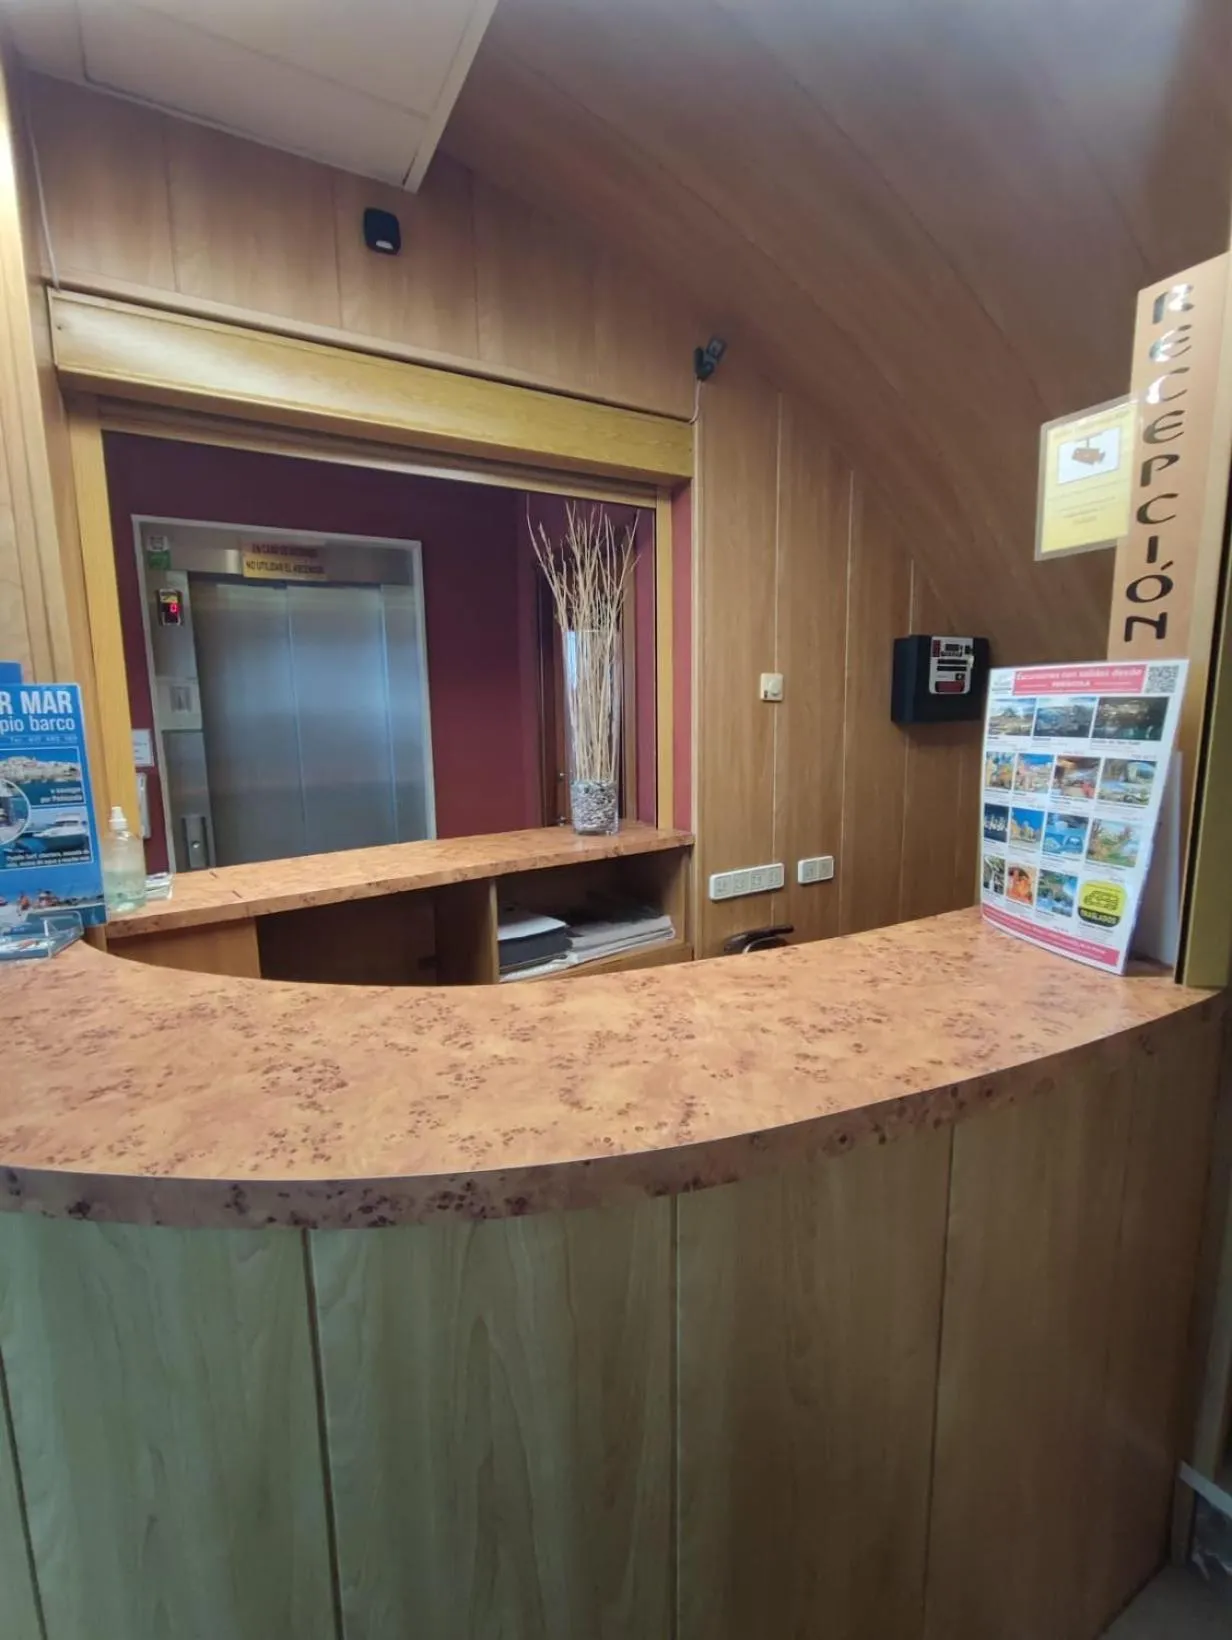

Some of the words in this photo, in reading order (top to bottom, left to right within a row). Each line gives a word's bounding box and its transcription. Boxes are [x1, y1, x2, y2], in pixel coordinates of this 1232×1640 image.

[1123, 282, 1194, 643] RECEPCIÓN
[21, 690, 73, 714] MAR
[0, 715, 24, 735] pio
[29, 715, 75, 731] barco
